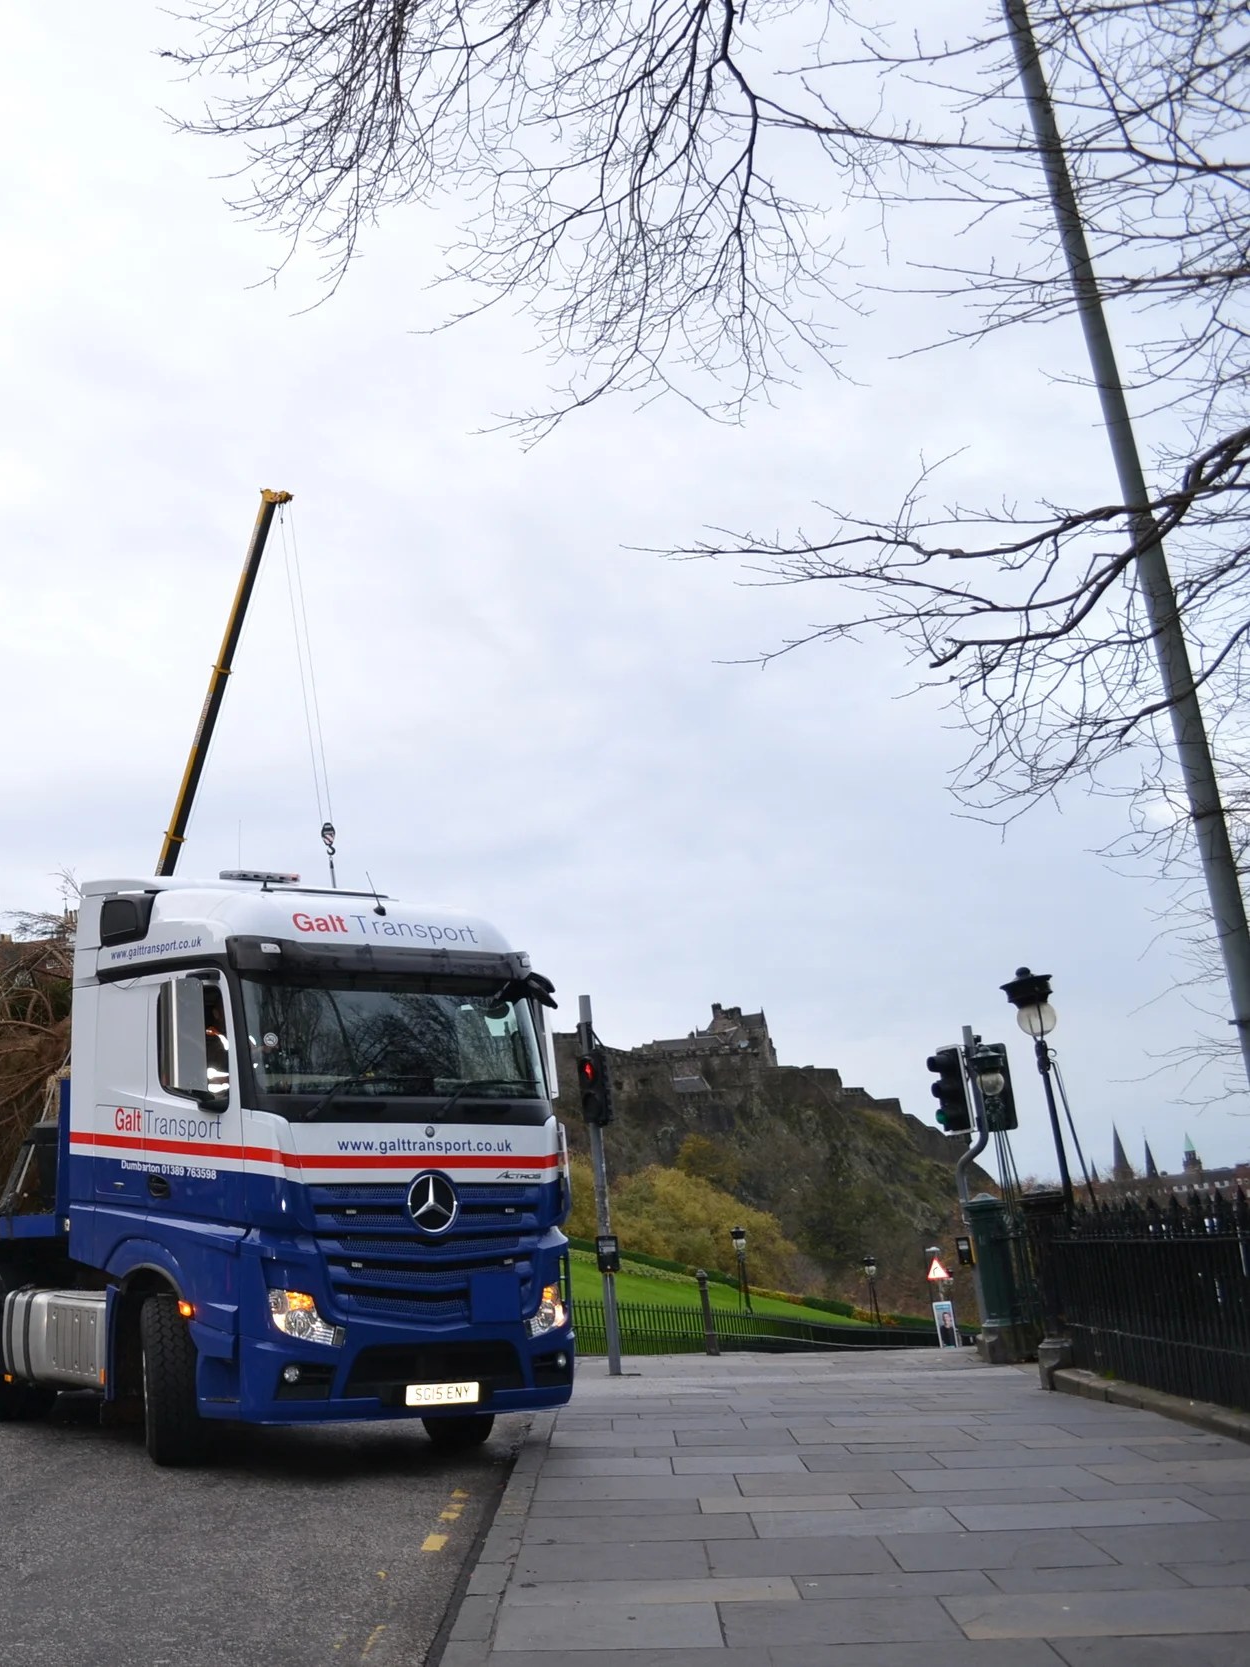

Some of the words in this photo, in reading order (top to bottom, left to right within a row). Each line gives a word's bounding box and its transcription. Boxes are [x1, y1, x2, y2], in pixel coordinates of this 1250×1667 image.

[292, 913, 348, 933] Galt
[350, 914, 479, 945] Transport
[111, 936, 202, 960] www.galttransport.co.uk
[115, 1107, 142, 1132] Galt
[144, 1109, 221, 1141] Transport
[337, 1138, 513, 1155] www.galttransport.co.uk
[121, 1160, 160, 1174] Dumbarton
[161, 1164, 184, 1177] 01389
[186, 1167, 217, 1180] 763598
[415, 1386, 443, 1401] SG15
[447, 1385, 470, 1400] ENY
